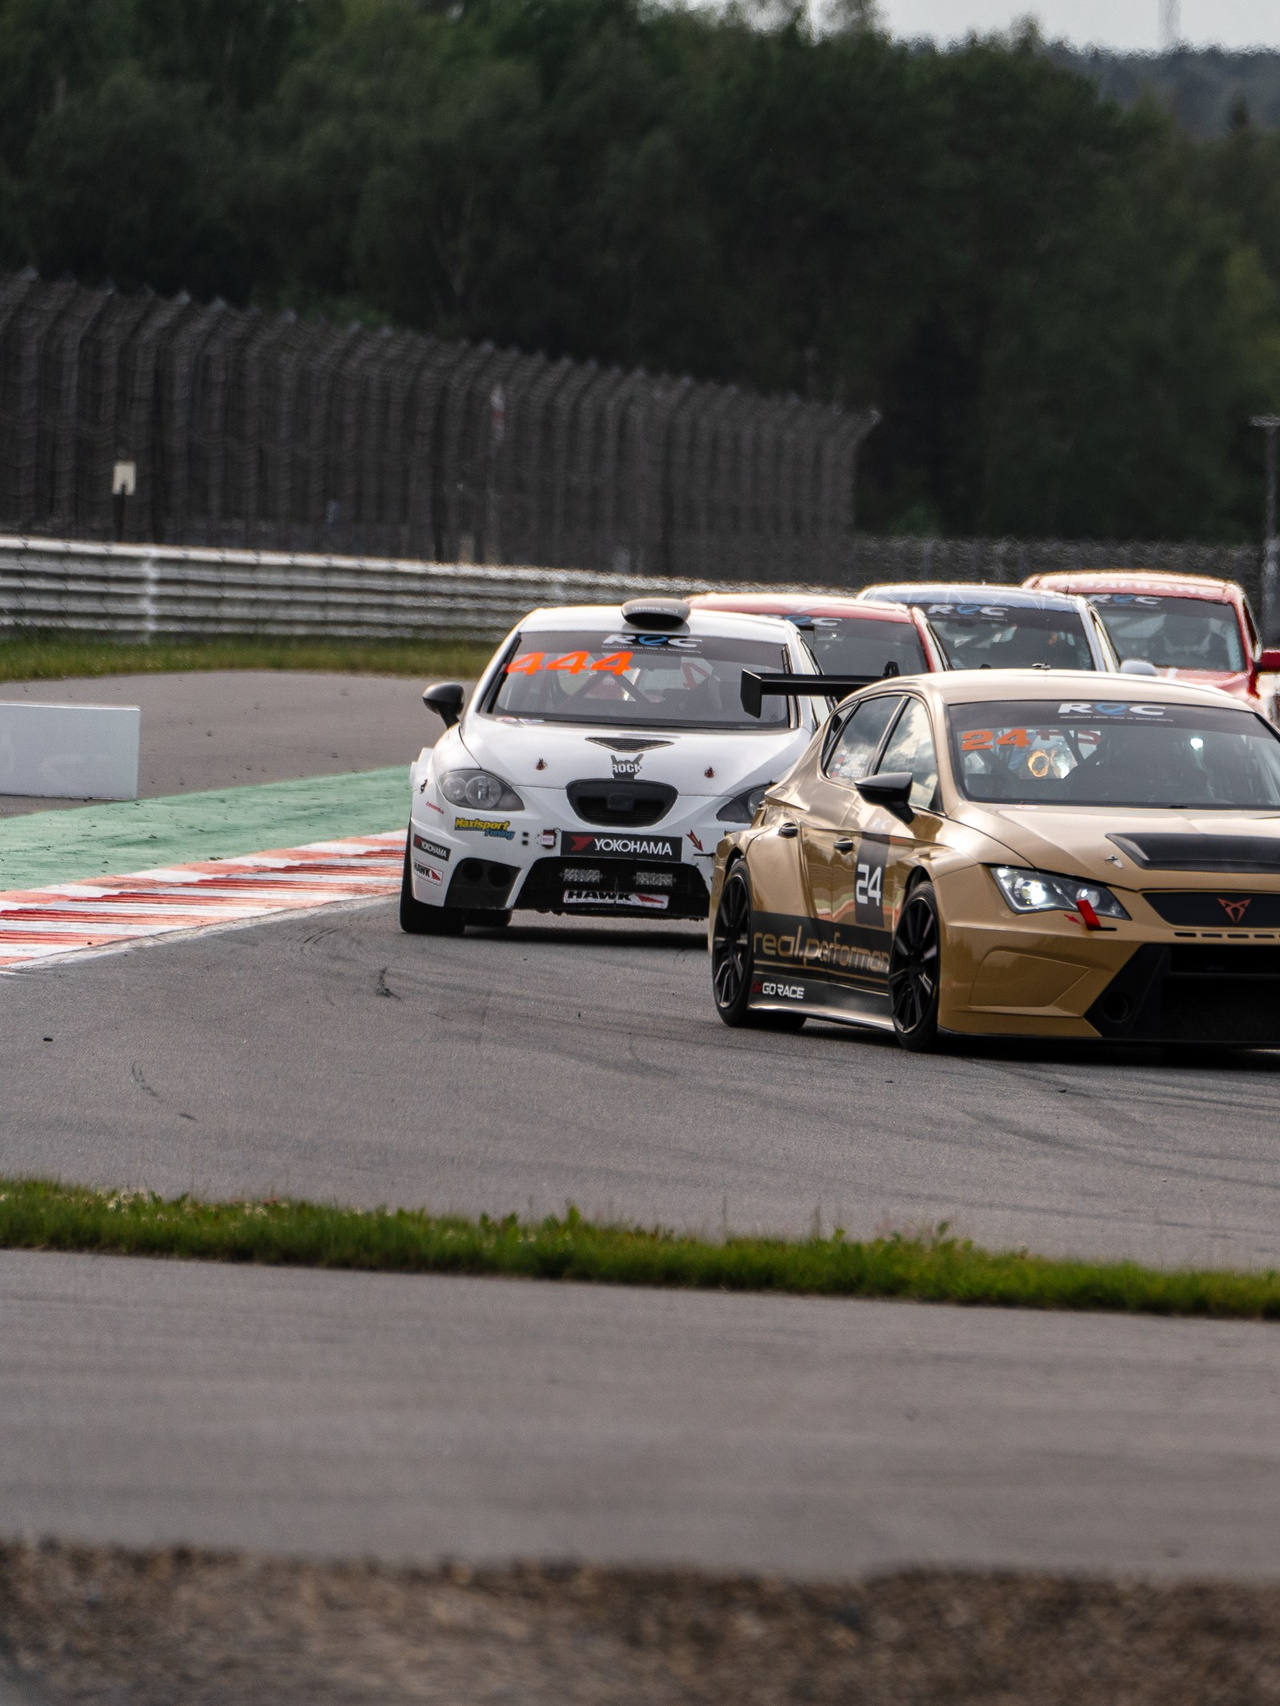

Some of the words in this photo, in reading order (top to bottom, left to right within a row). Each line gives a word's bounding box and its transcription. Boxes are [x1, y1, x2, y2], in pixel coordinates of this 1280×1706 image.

[505, 651, 634, 676] 444
[961, 728, 1031, 751] 24
[612, 762, 643, 774] ROCK
[594, 838, 673, 856] YOKOHAMA
[414, 861, 431, 878] HAWK
[856, 864, 882, 907] 24
[567, 890, 633, 902] HAWK
